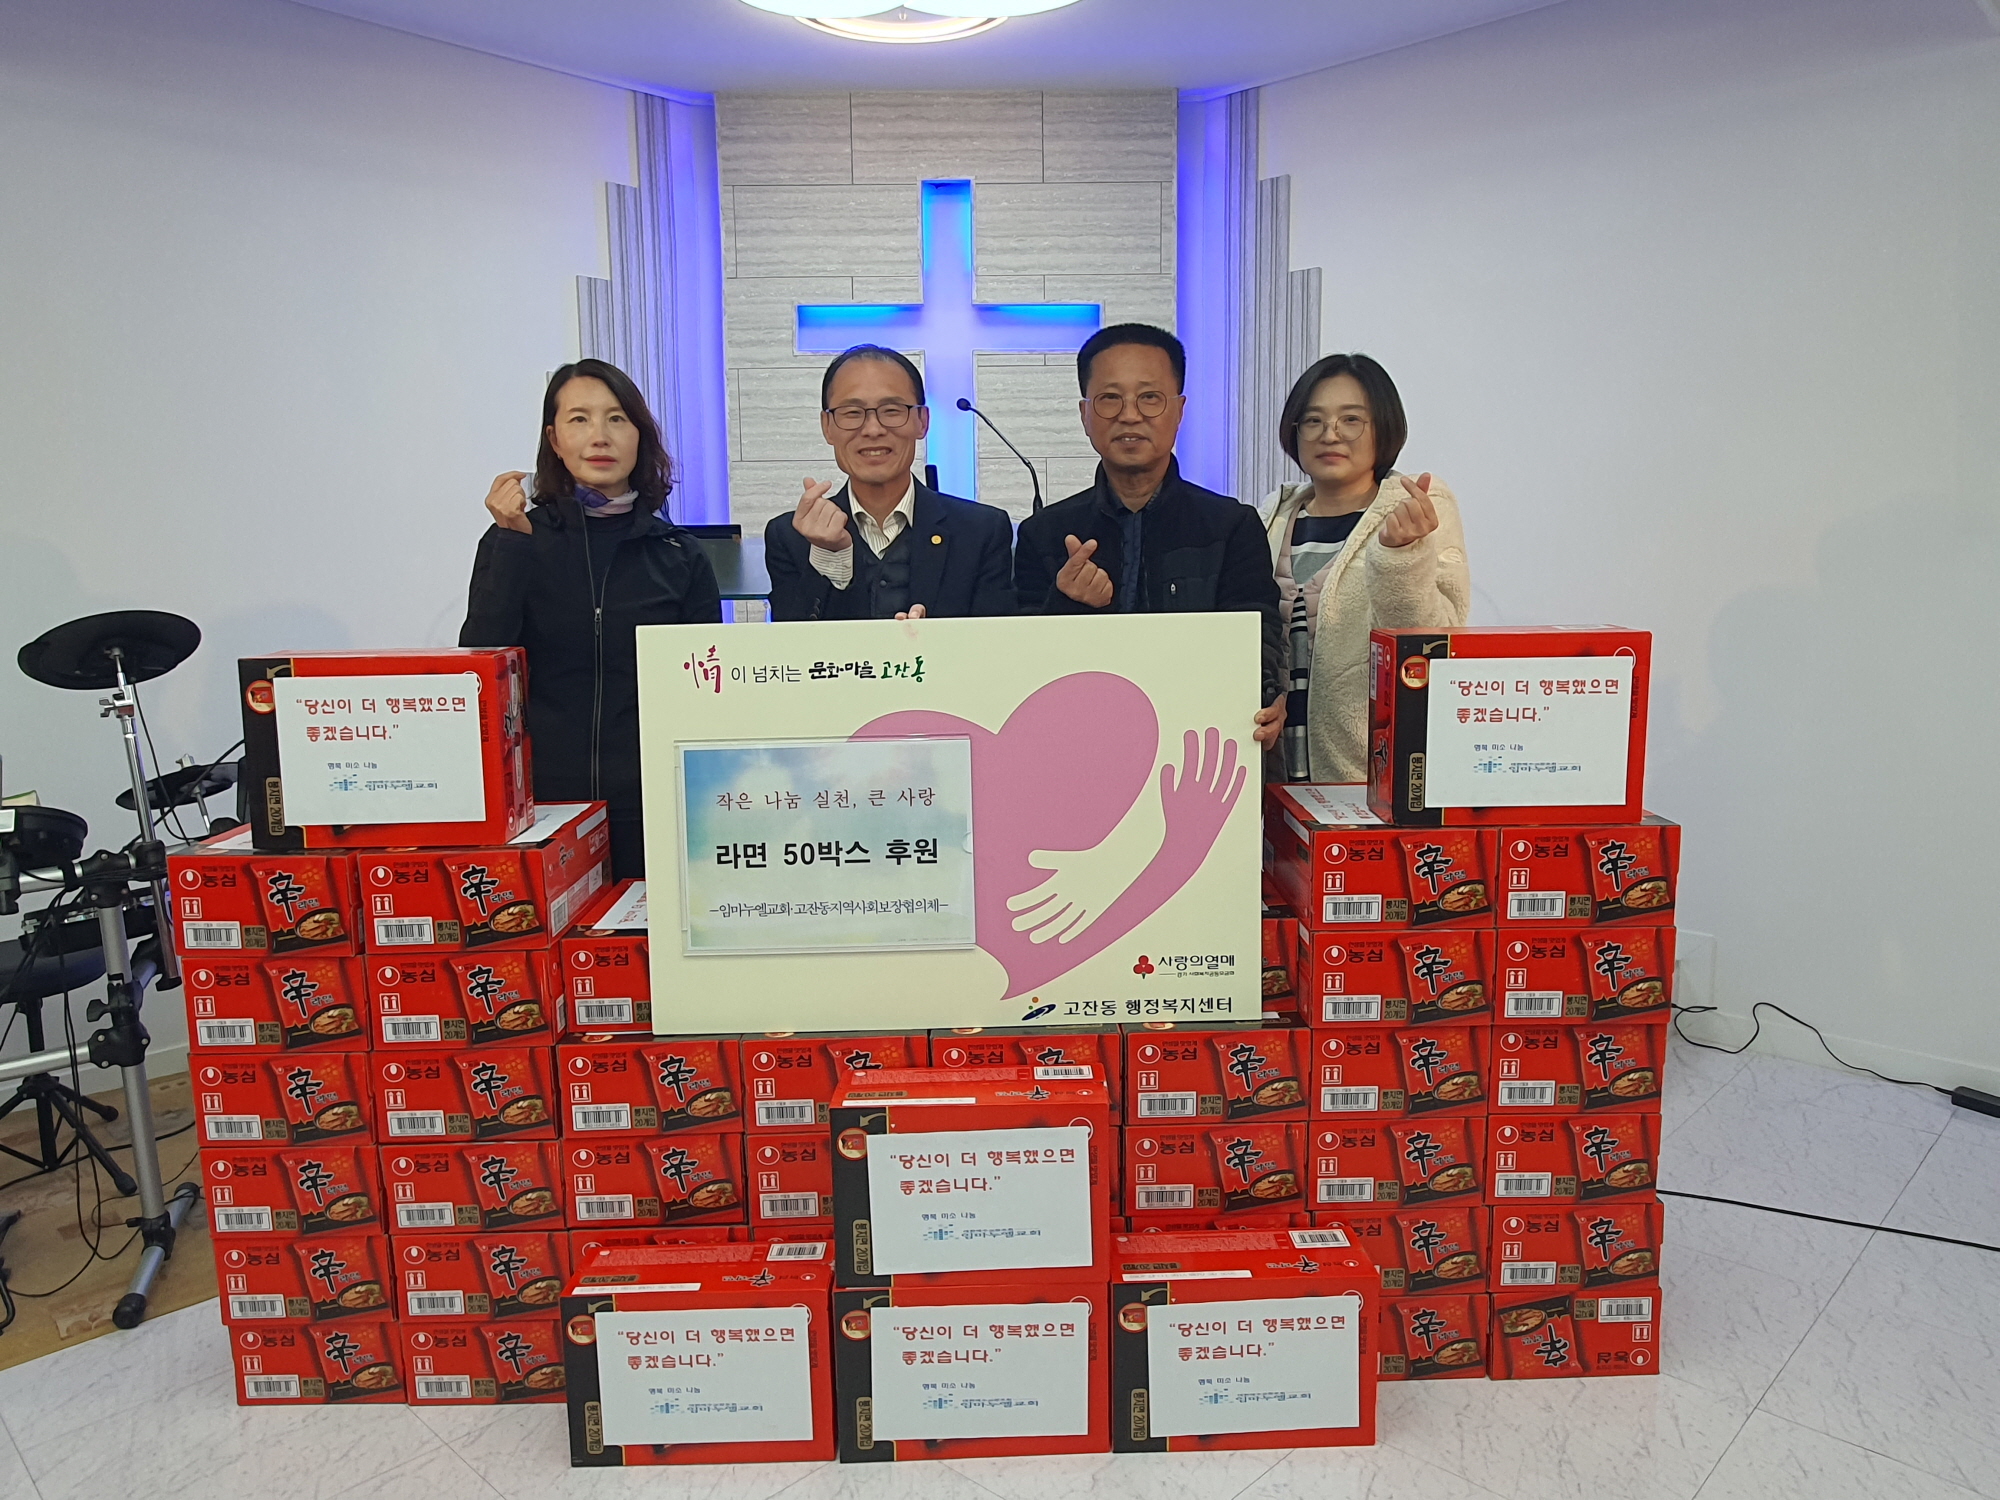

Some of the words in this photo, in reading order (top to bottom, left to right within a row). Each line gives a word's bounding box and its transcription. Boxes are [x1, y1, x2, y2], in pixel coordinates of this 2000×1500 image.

[731, 665, 746, 683] 이
[753, 665, 801, 683] 넘치는
[880, 656, 925, 682] 고잔동
[1515, 680, 1529, 695] 더
[1540, 679, 1619, 695] 행복했으면
[362, 699, 376, 713] 더
[386, 697, 466, 713] 행복했으면
[716, 792, 753, 811] 작은
[764, 791, 801, 810] 나눔
[813, 790, 857, 809] 실천,
[868, 790, 886, 806] 큰
[897, 787, 936, 807] 사랑
[716, 843, 767, 869] 라면
[783, 840, 871, 867] 50박스
[885, 838, 938, 866] 후원
[1348, 847, 1384, 861] 농심
[1534, 844, 1569, 858] 농심
[1415, 843, 1453, 895] 辛
[1600, 840, 1637, 891] 辛
[1626, 867, 1649, 878] 라면
[202, 874, 236, 887] 농심
[394, 869, 428, 884] 농심
[1443, 870, 1466, 881] 라면
[268, 872, 304, 922] 辛
[461, 864, 498, 916] 辛
[491, 892, 514, 902] 라면
[1386, 900, 1407, 909] 봉지면
[1569, 897, 1590, 906] 봉지면
[1385, 911, 1406, 920] 20개입
[1569, 907, 1590, 917] 20개입
[437, 922, 458, 931] 봉지면
[438, 932, 459, 942] 20개입
[1348, 949, 1384, 963] 농심
[1532, 945, 1566, 958] 농심
[595, 953, 629, 967] 농심
[1158, 955, 1234, 971] 사랑의열매
[1596, 941, 1632, 991] 辛
[401, 969, 435, 983] 농심
[1414, 945, 1452, 994] 辛
[215, 973, 250, 986] 농심
[282, 968, 318, 1018] 辛
[467, 965, 504, 1014] 辛
[1064, 1001, 1117, 1016] 고잔동
[1126, 997, 1232, 1016] 행정복지센터
[1346, 1042, 1380, 1055] 농심
[1524, 1036, 1558, 1049] 농심
[777, 1055, 812, 1068] 농심
[968, 1052, 1004, 1064] 농심
[1162, 1048, 1197, 1061] 농심
[1588, 1034, 1623, 1081] 辛
[593, 1059, 627, 1073] 농심
[1229, 1043, 1266, 1090] 辛
[1411, 1038, 1447, 1086] 辛
[222, 1070, 256, 1084] 농심
[406, 1067, 440, 1080] 농심
[660, 1055, 696, 1102] 辛
[287, 1068, 323, 1116] 辛
[472, 1062, 508, 1109] 辛
[1201, 1096, 1221, 1104] 봉지면
[634, 1108, 655, 1117] 봉지면
[1200, 1106, 1221, 1114] 20개입
[635, 1118, 655, 1127] 20개입
[1342, 1135, 1376, 1148] 농심
[1520, 1129, 1554, 1142] 농심
[1160, 1142, 1194, 1154] 농심
[1406, 1132, 1442, 1177] 辛
[1583, 1126, 1619, 1173] 辛
[596, 1152, 630, 1165] 농심
[782, 1149, 816, 1162] 농심
[962, 1152, 976, 1166] 더
[987, 1149, 1075, 1167] 행복했으면
[1226, 1138, 1262, 1183] 辛
[233, 1164, 267, 1177] 농심
[415, 1160, 449, 1173] 농심
[662, 1147, 698, 1193] 辛
[299, 1160, 334, 1207] 辛
[481, 1156, 517, 1201] 辛
[1525, 1221, 1559, 1233] 농심
[1412, 1220, 1447, 1265] 辛
[1588, 1216, 1622, 1262] 辛
[247, 1253, 280, 1266] 농심
[427, 1249, 459, 1262] 농심
[311, 1248, 346, 1294] 辛
[491, 1244, 527, 1290] 辛
[963, 1326, 978, 1339] 더
[989, 1323, 1075, 1340] 행복했으면
[1237, 1320, 1252, 1333] 더
[1262, 1316, 1345, 1333] 행복했으면
[1411, 1308, 1446, 1351] 辛
[263, 1335, 295, 1348] 농심
[434, 1335, 467, 1348] 농심
[686, 1330, 700, 1343] 더
[710, 1328, 795, 1343] 행복했으면
[325, 1331, 361, 1375] 辛
[498, 1331, 533, 1375] 辛
